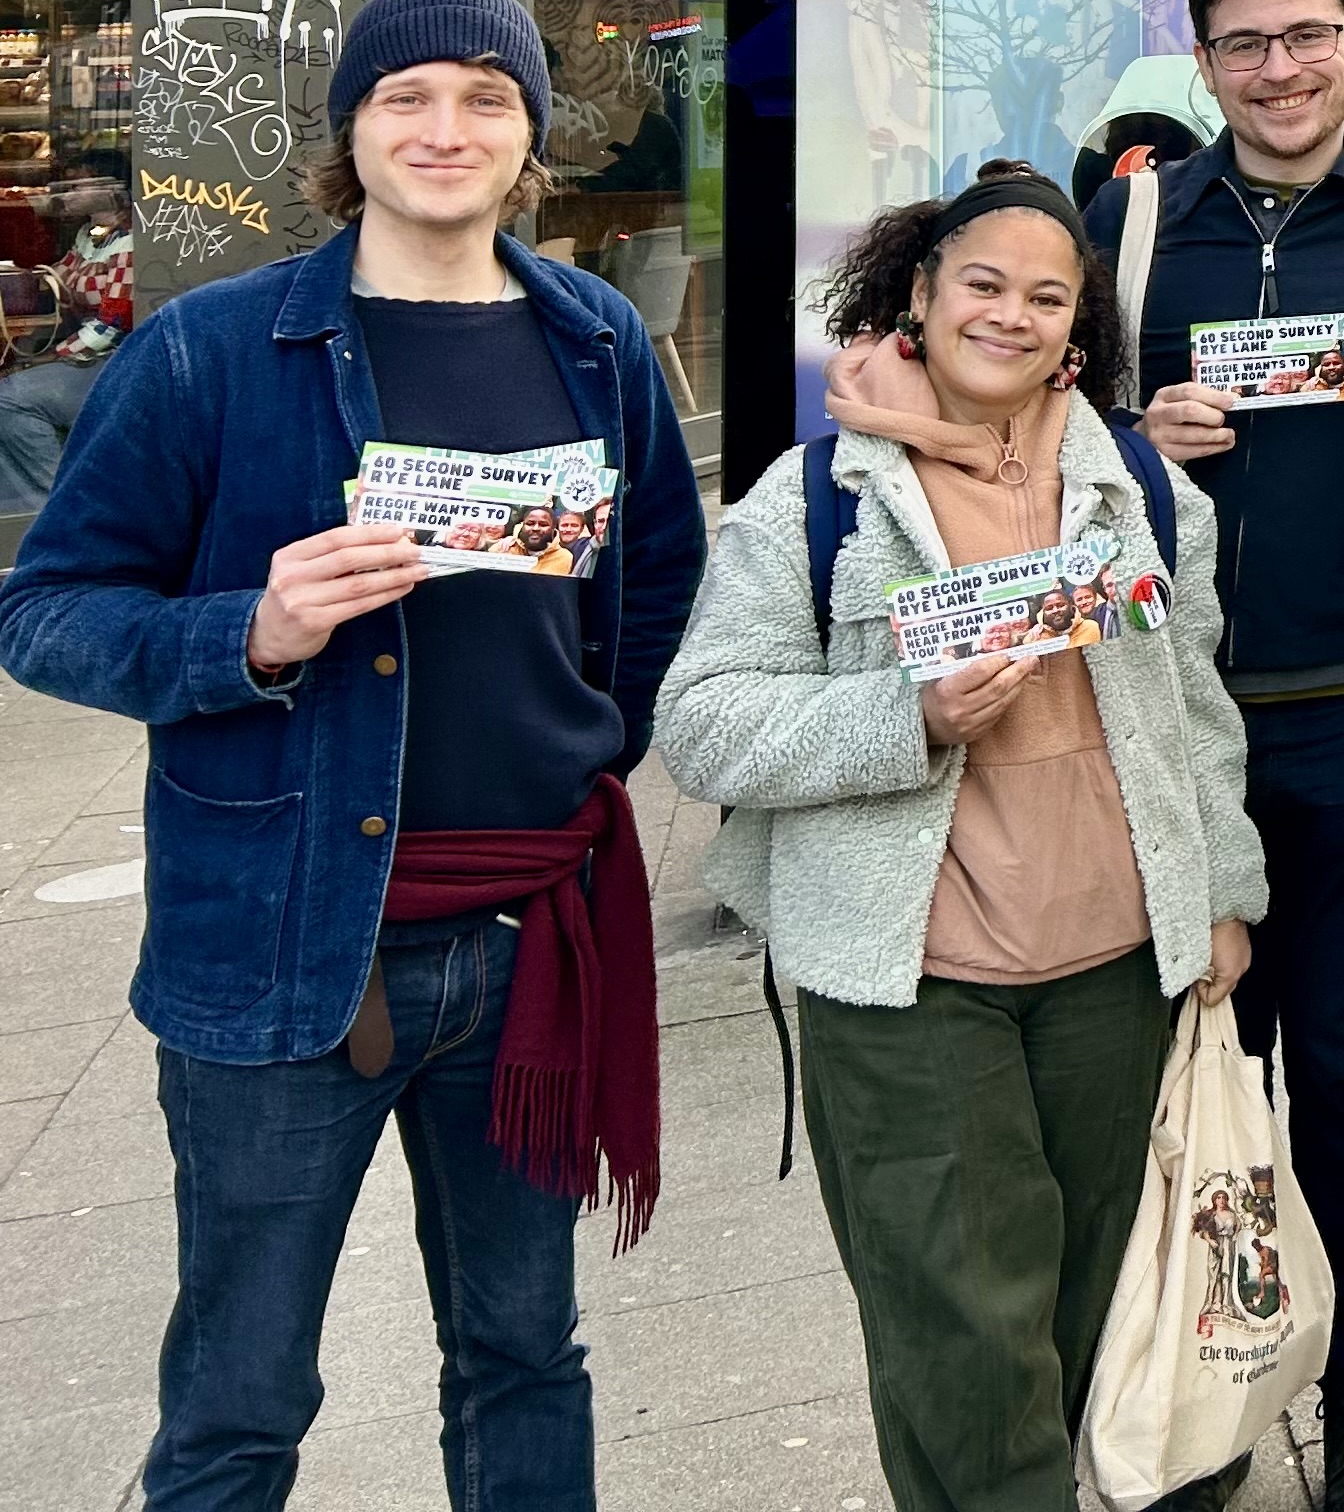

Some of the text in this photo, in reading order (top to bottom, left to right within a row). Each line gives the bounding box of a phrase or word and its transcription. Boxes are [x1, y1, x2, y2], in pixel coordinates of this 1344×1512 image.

[1200, 323, 1334, 343] 60 SECOND SURVEY
[1200, 341, 1268, 355] RYE LANE
[1200, 358, 1306, 375] REGGIE WANTS TO
[1200, 370, 1267, 384] HEAR FROM
[370, 469, 463, 491] RYE LANE
[373, 455, 553, 486] 60 SECOND SURVEY
[362, 508, 403, 521] HEAR
[408, 513, 452, 526] FROM
[365, 496, 505, 520] REGGIE WANTS TO
[897, 560, 1051, 605] 60 SECOND SURVEY
[899, 592, 978, 618] RYE LANE
[904, 604, 1025, 638] REGGIE WANTS TO
[906, 626, 982, 650] HEAR FROM
[909, 646, 938, 660] YOU!
[1200, 1345, 1221, 1362] The
[1232, 1368, 1245, 1384] of
